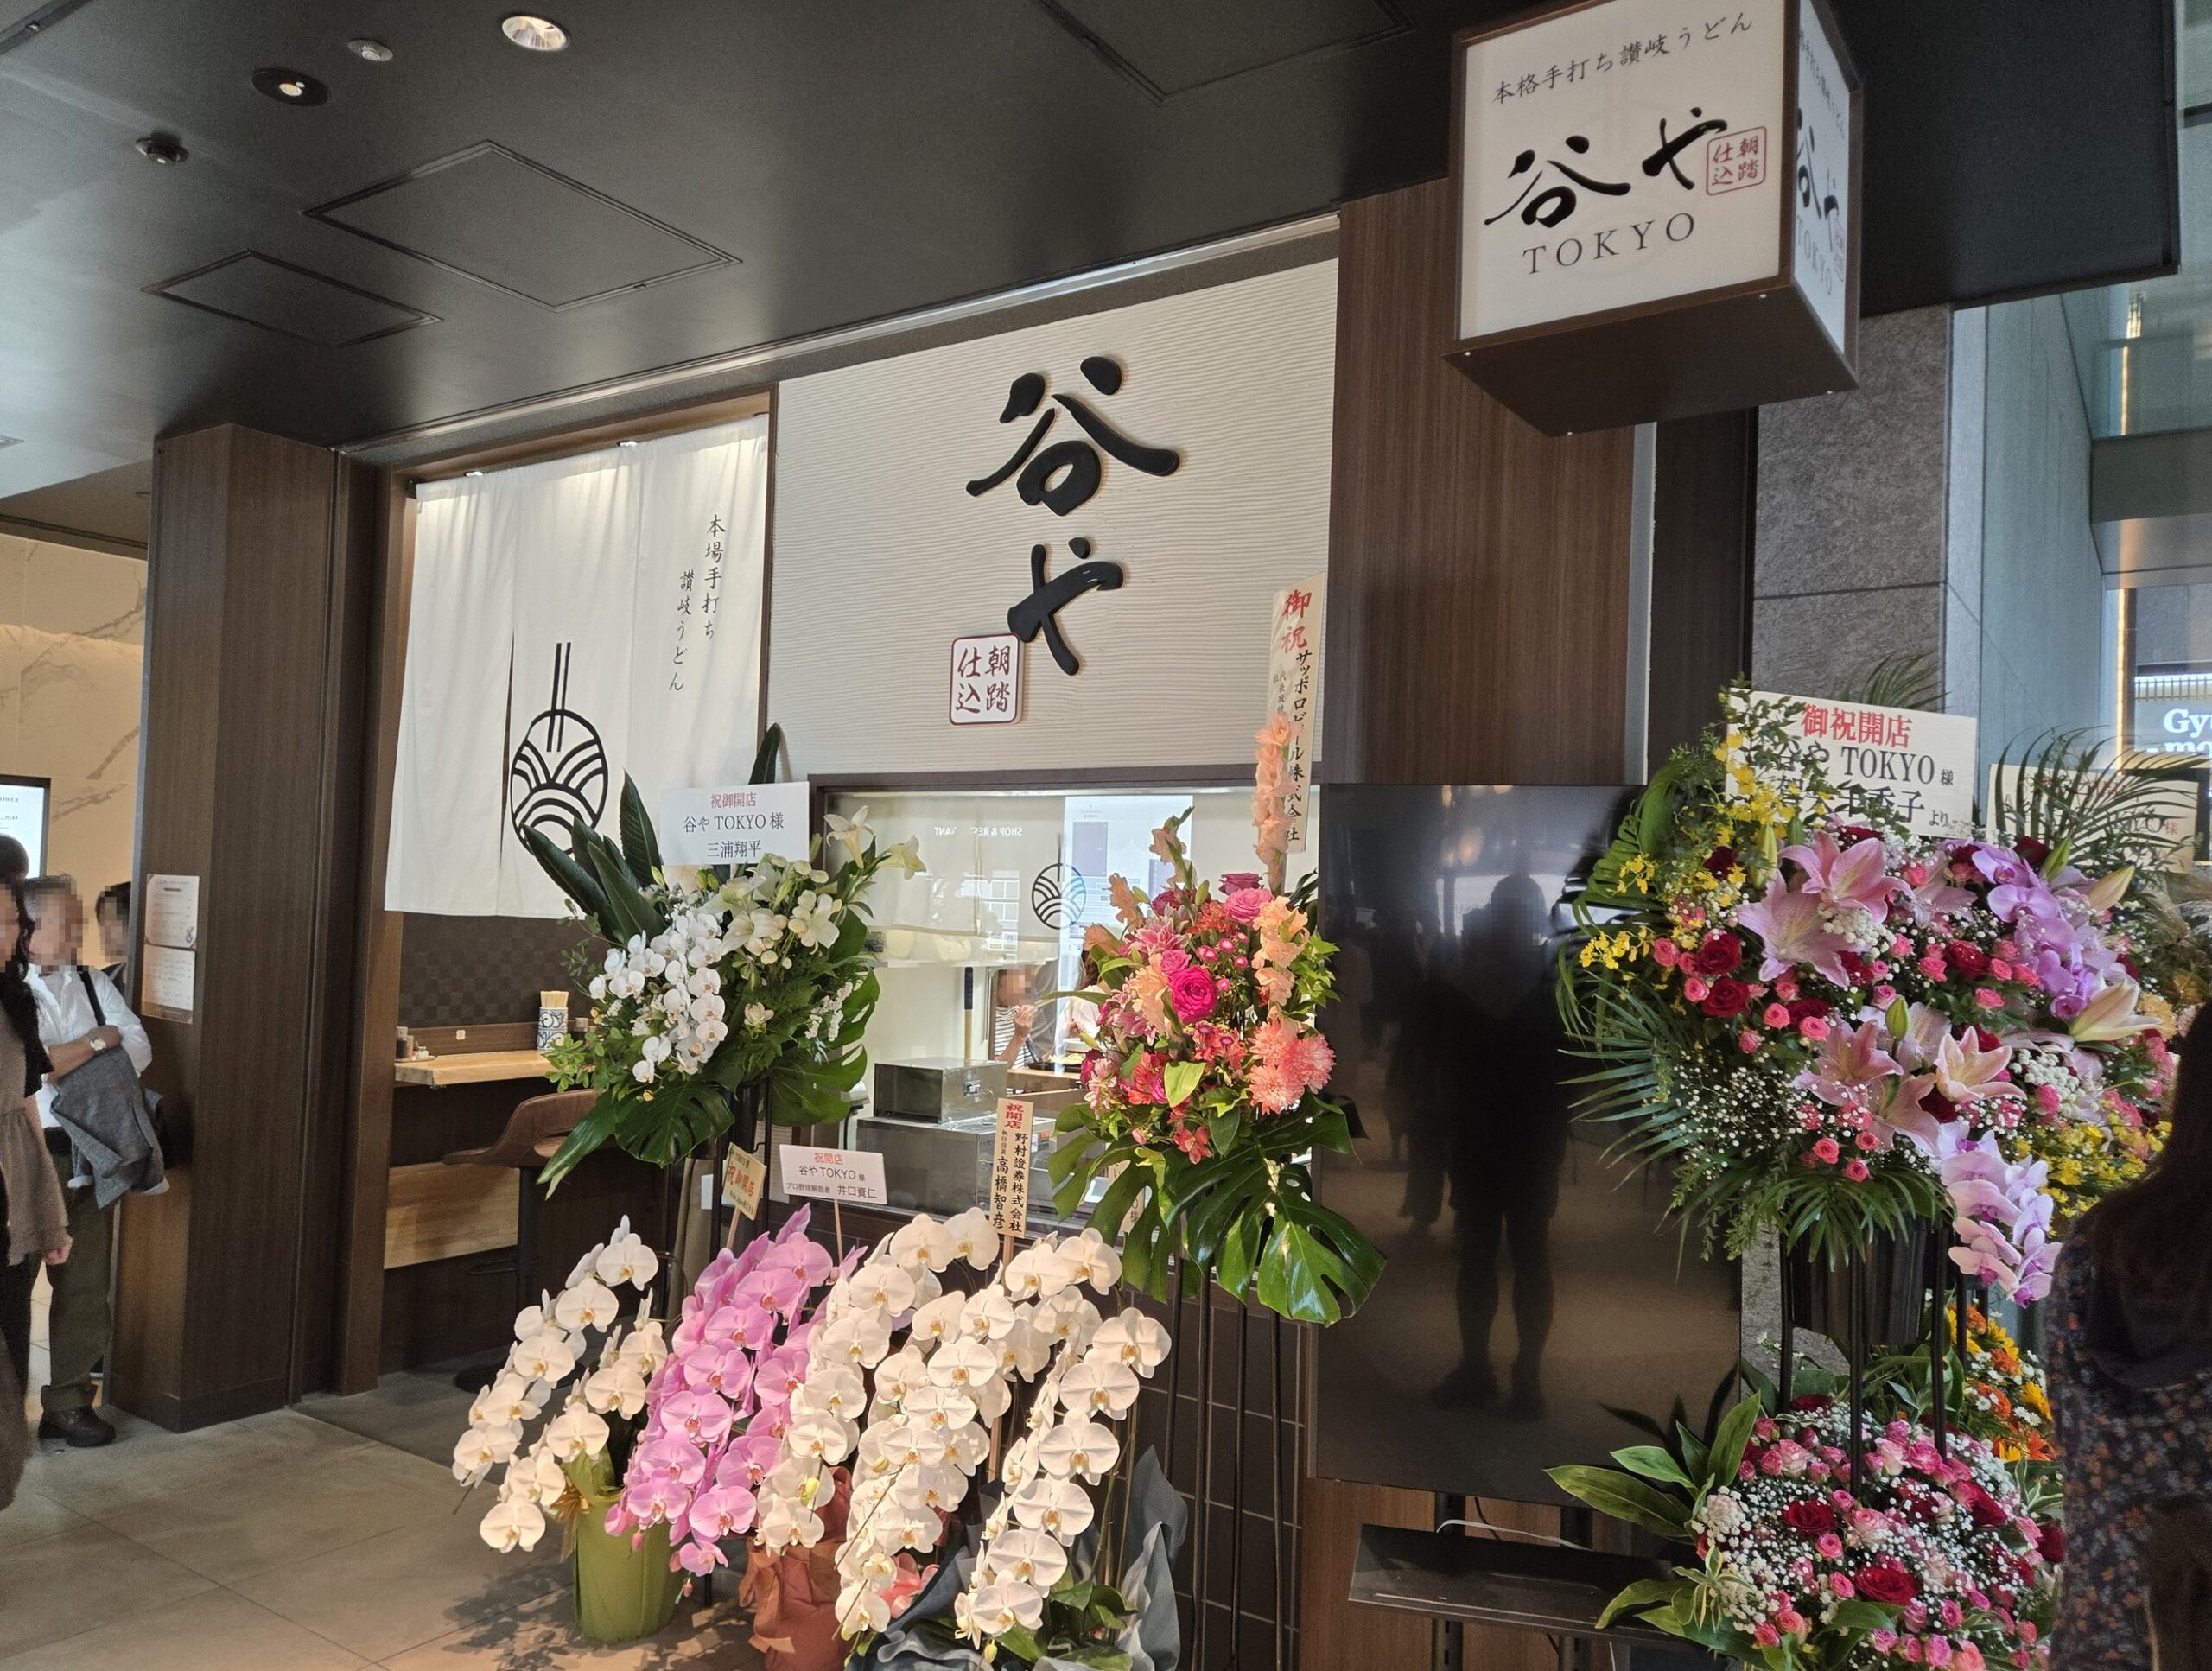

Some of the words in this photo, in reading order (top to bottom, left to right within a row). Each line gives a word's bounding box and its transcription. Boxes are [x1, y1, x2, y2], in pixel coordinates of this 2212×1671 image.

[1492, 12, 1753, 105] 本格手打ち讃岐うどん
[1484, 107, 1728, 228] 谷や
[1522, 213, 1695, 274] TOKYO
[966, 356, 1180, 676] 谷や
[702, 514, 726, 639] 本場手打ち
[669, 569, 694, 691] 讃岐うどん
[1281, 589, 1312, 654] 御祝
[1801, 704, 1913, 748] 御祝開店
[2164, 708, 2212, 738] Gy
[1841, 746, 1935, 785] TOKYO
[1940, 769, 1954, 786] 様
[710, 791, 757, 809] 祝御開店
[1929, 810, 1949, 827] より
[683, 816, 710, 833] 谷や
[715, 814, 766, 830] TOKYO
[770, 812, 784, 830] 様
[707, 840, 761, 858] 三浦翔平
[1005, 1103, 1024, 1129] 祝開店
[799, 1165, 817, 1176] 谷や
[819, 1167, 855, 1180] TOKYO
[815, 1153, 843, 1165] 祝開店
[837, 1185, 877, 1198] 井口資仁
[993, 1155, 1009, 1229] 高橋智彦
[1009, 1133, 1028, 1232] 野村證券株式会社
